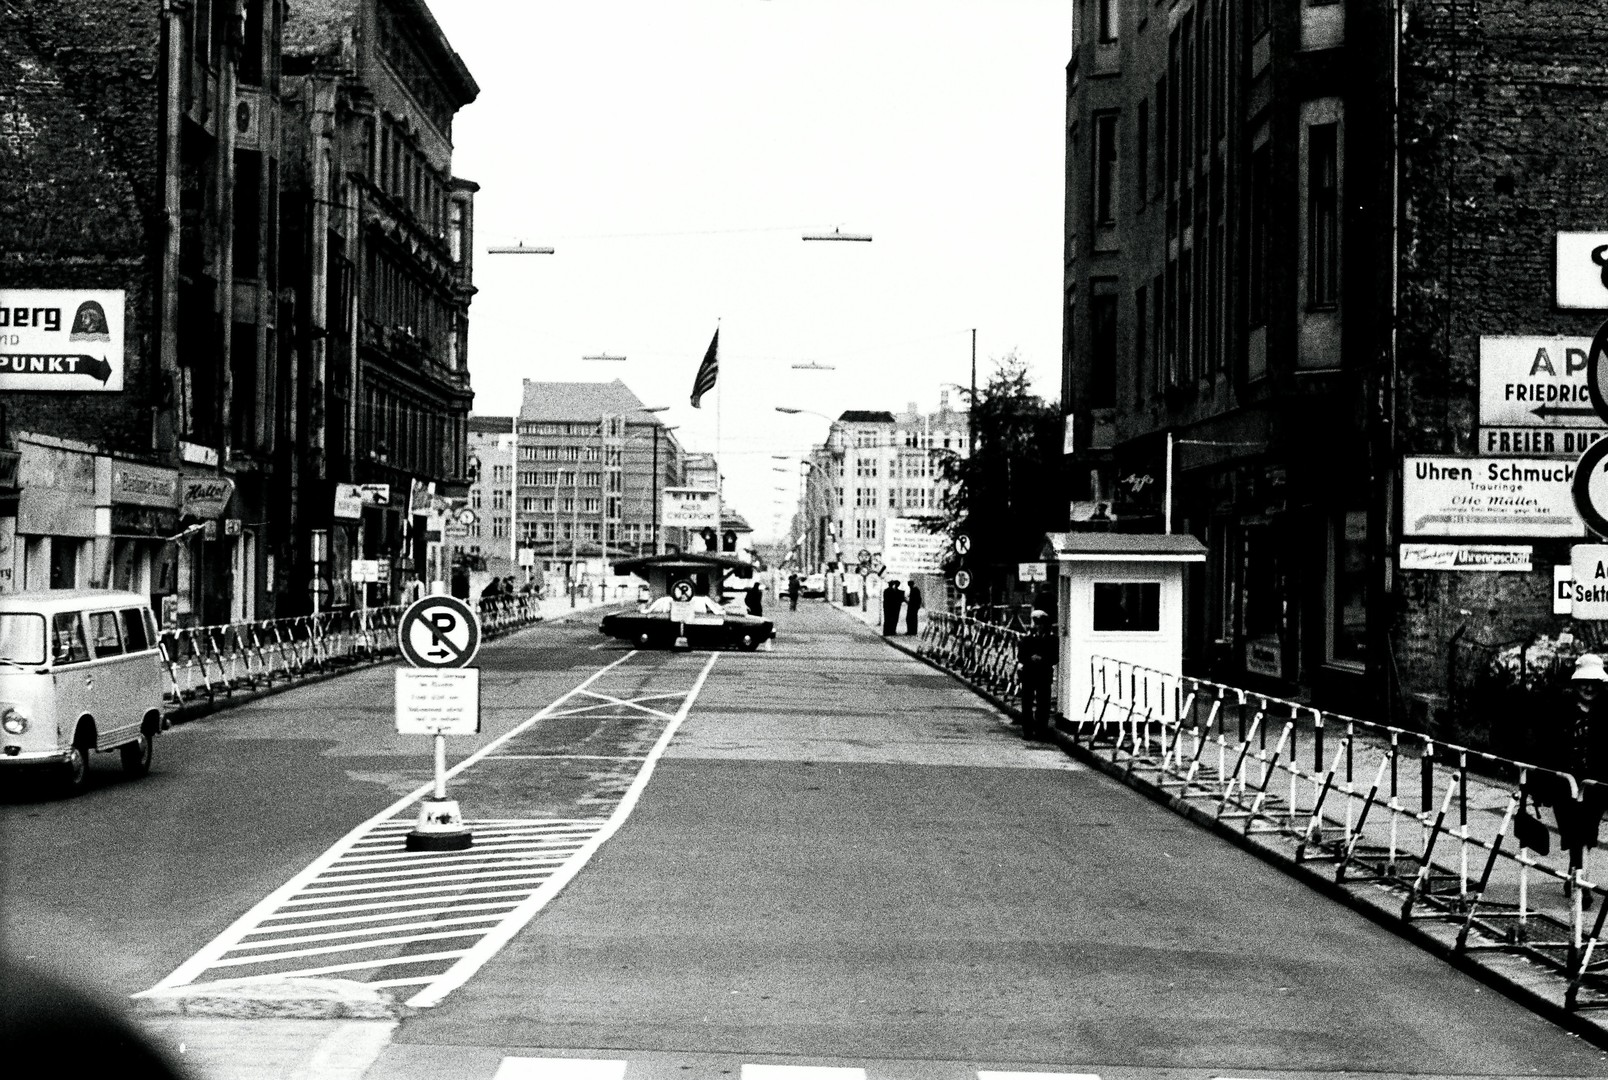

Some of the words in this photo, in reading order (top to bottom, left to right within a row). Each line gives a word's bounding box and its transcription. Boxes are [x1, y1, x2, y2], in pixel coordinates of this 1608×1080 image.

[1488, 432, 1554, 453] FREIER
[1416, 462, 1472, 481] Uhren
[1488, 463, 1574, 482] Schmuck
[1470, 482, 1523, 493] Trauringe
[1575, 585, 1608, 602] Sekt
